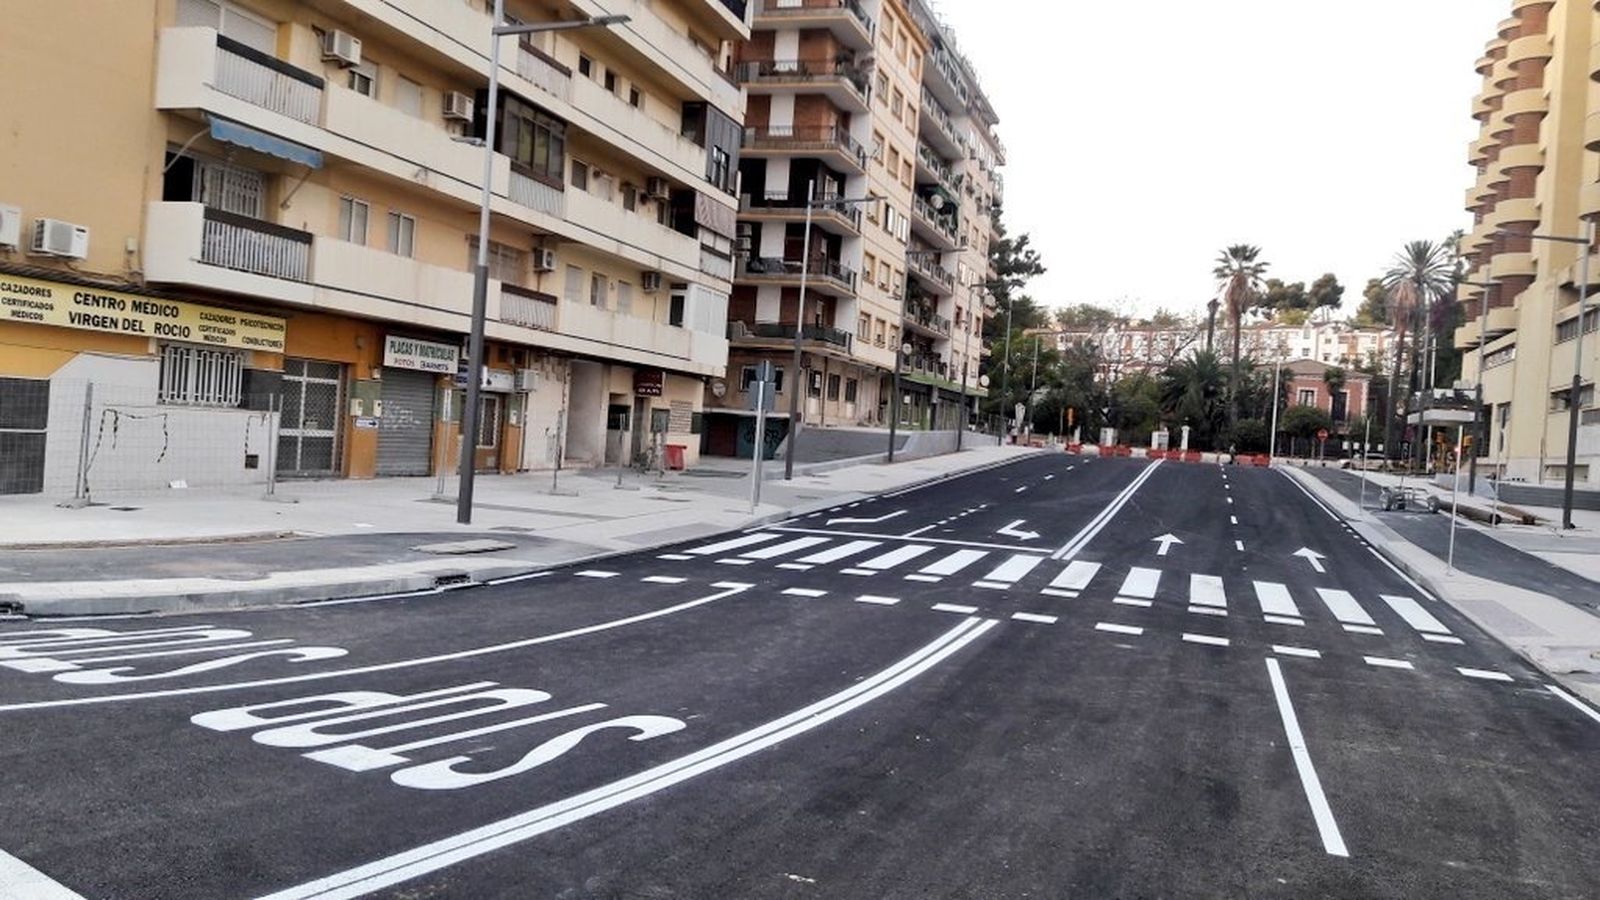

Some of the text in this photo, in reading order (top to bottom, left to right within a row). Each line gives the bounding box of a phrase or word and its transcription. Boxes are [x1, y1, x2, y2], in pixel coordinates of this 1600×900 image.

[1, 282, 52, 298] CAZADORES
[1, 296, 54, 311] CERTIFICADOS
[73, 291, 126, 312] CENTRO
[68, 311, 119, 329] VIRGEN
[121, 318, 145, 333] DEL
[200, 312, 236, 325] CAZADORES
[198, 324, 237, 336] CERTIFICADOS
[389, 340, 413, 356] PLACAS
[414, 343, 419, 356] Y
[190, 681, 687, 790] STOP
